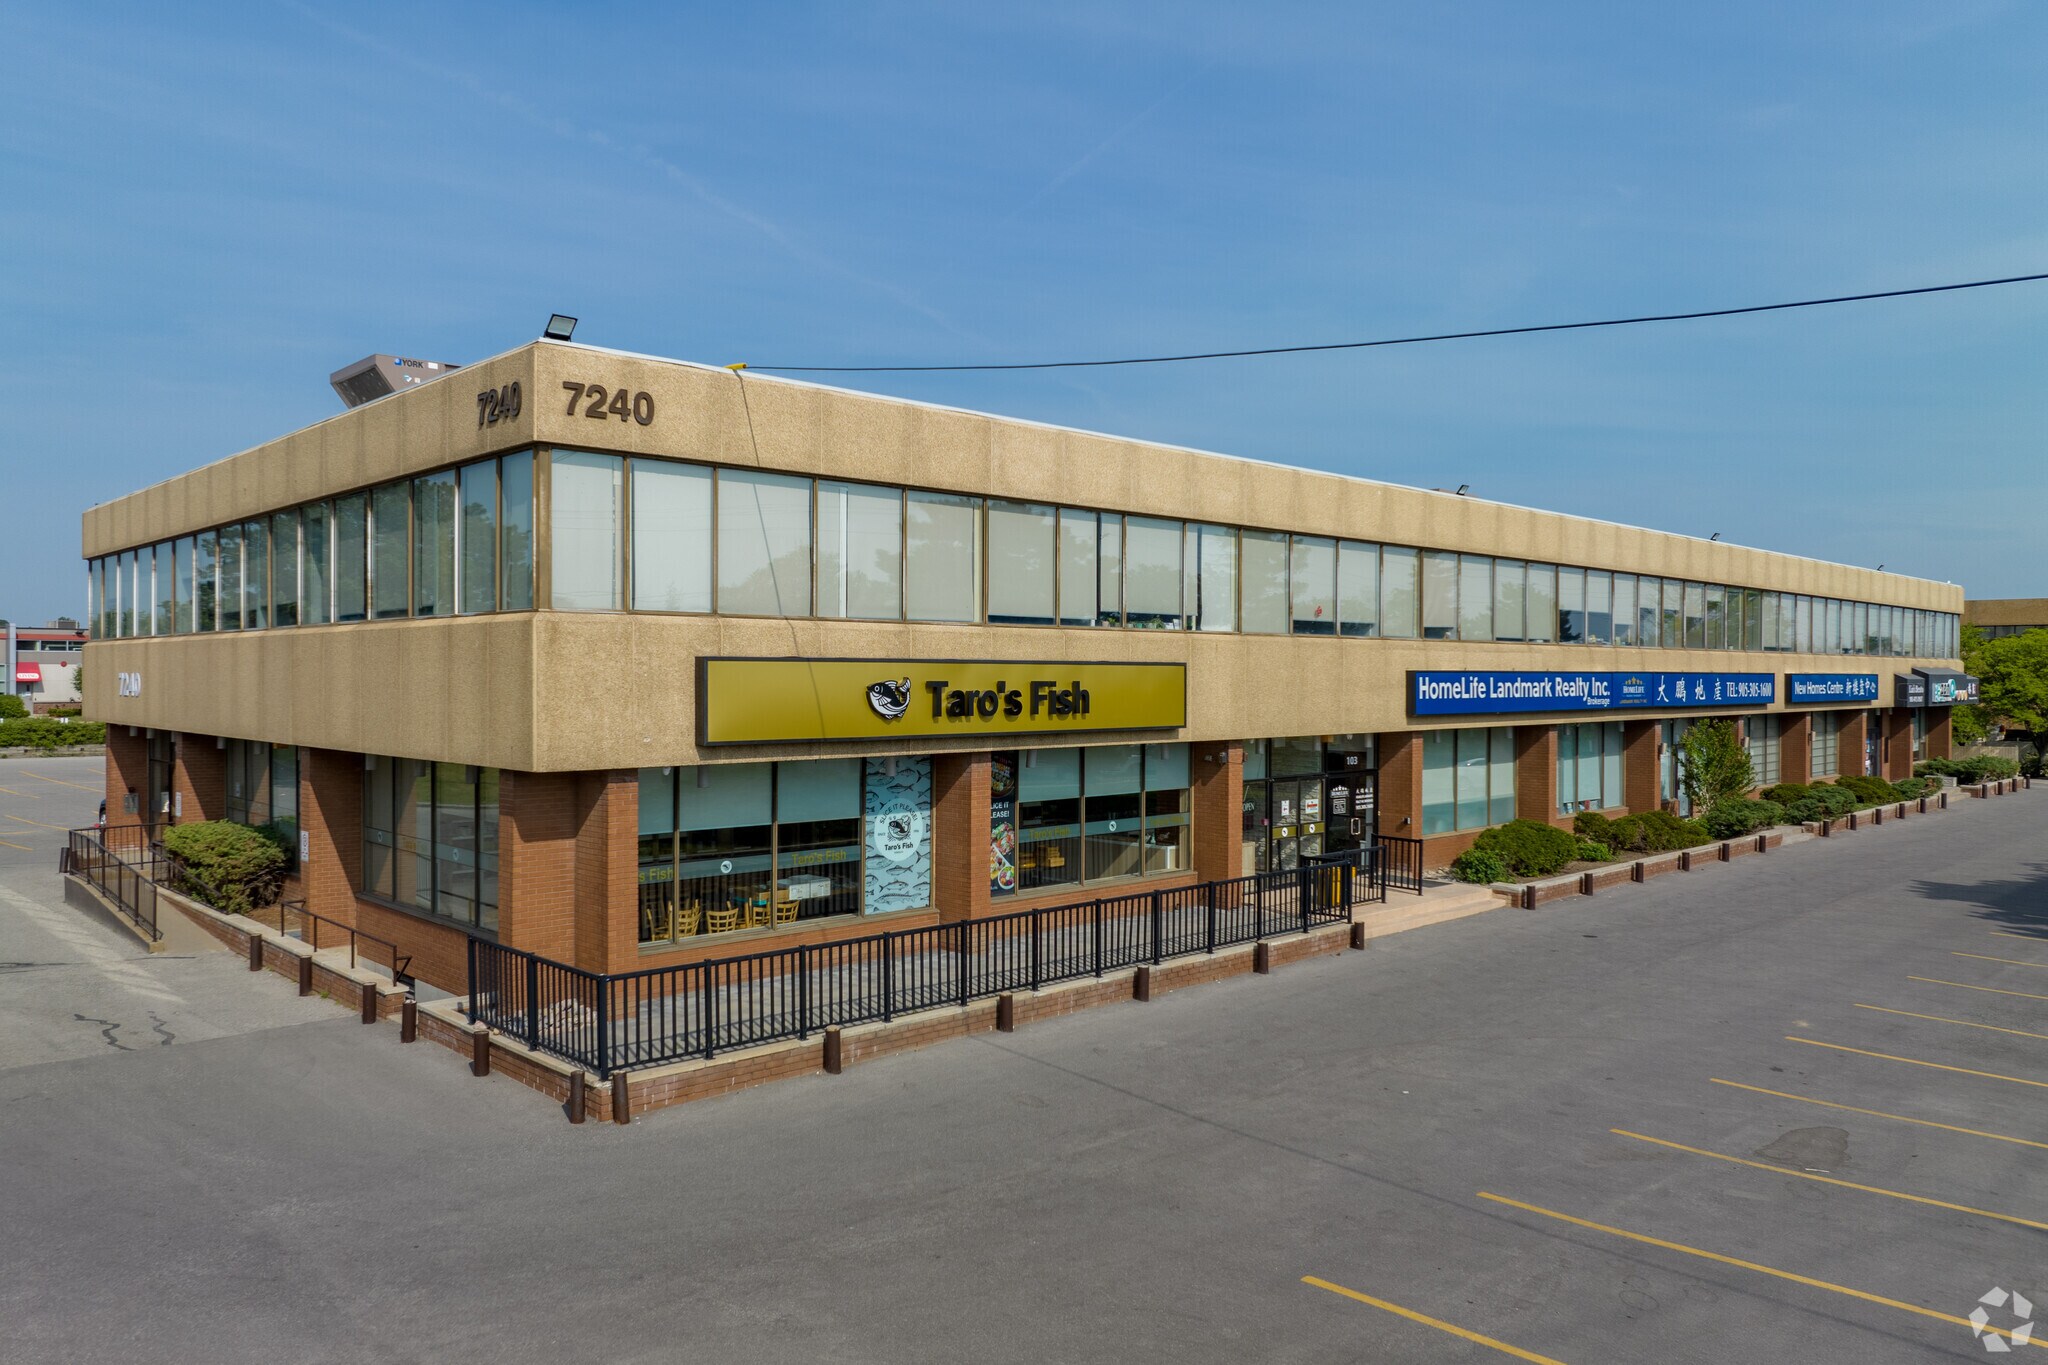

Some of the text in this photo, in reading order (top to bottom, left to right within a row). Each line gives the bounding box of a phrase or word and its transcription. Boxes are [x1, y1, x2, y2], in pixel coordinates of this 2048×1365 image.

[402, 359, 424, 369] YORK
[477, 381, 523, 426] 7240
[562, 380, 655, 427] 7240
[118, 672, 142, 698] 7240
[1418, 676, 1611, 701] HomeLife Landmark Realty Inc.
[1794, 680, 1844, 695] New Homes Centre
[925, 680, 1090, 718] Taro's Fish
[1586, 697, 1611, 707] Brokerage
[1346, 756, 1358, 765] 103
[880, 802, 918, 825] SLICE IT PLEASE!
[990, 810, 1010, 819] EASE!
[884, 841, 914, 851] Taro's Fish
[791, 849, 847, 866] Taro's Fish
[649, 867, 674, 881] Fish
